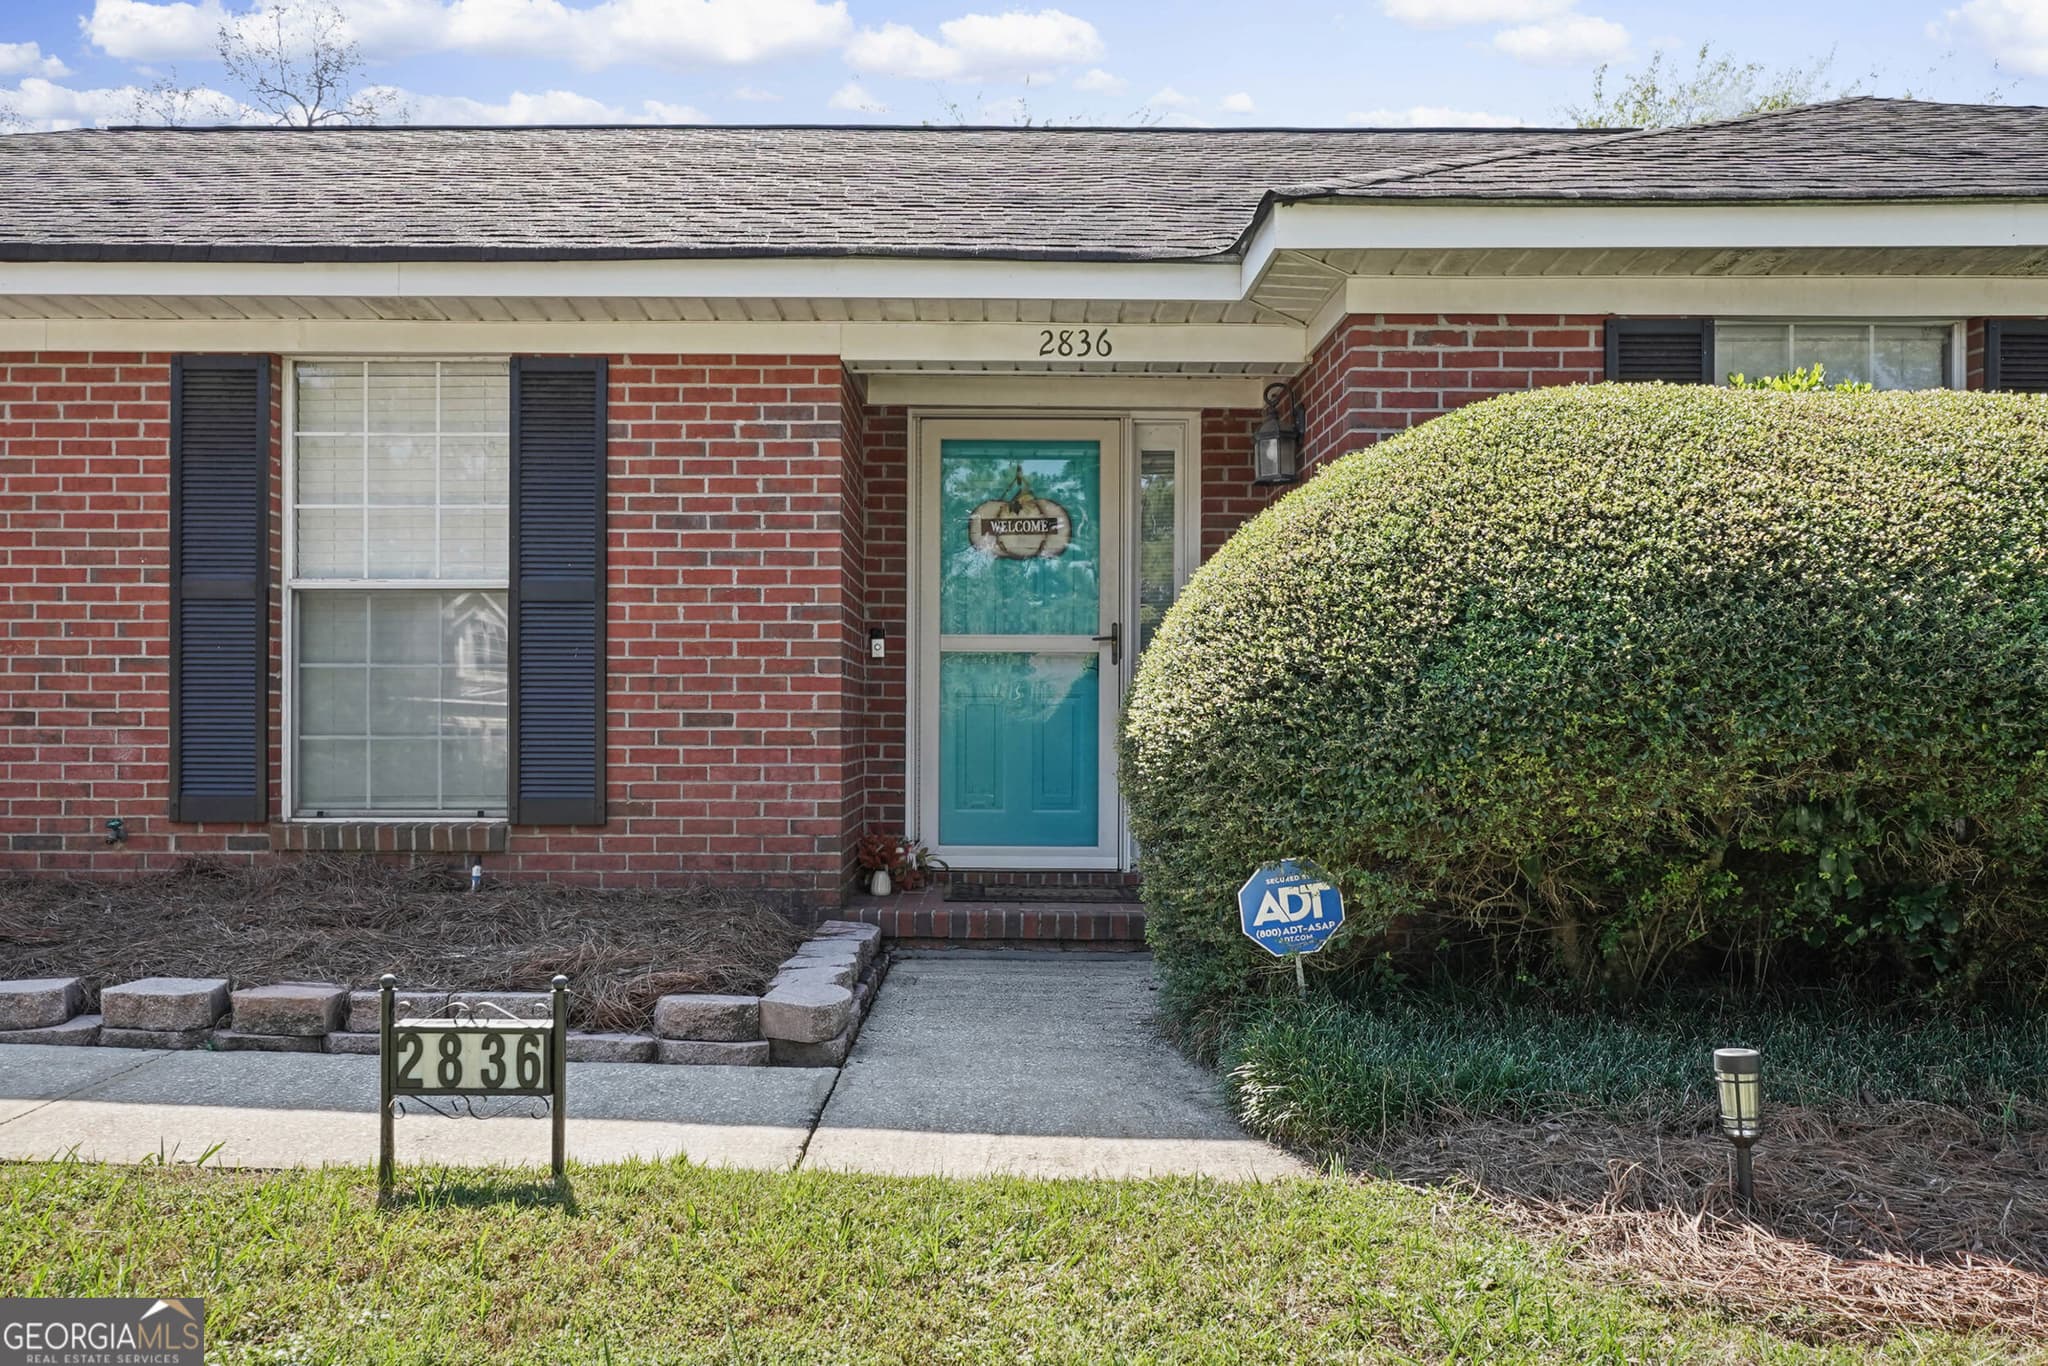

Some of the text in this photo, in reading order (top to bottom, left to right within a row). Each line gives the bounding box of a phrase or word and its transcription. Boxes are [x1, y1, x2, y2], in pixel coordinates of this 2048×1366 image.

[1039, 328, 1113, 357] 2836
[990, 520, 1049, 533] WELCOME
[1252, 882, 1331, 926] ADT
[1256, 920, 1336, 940] (800) ADT-ASAP
[397, 1032, 541, 1089] 2836
